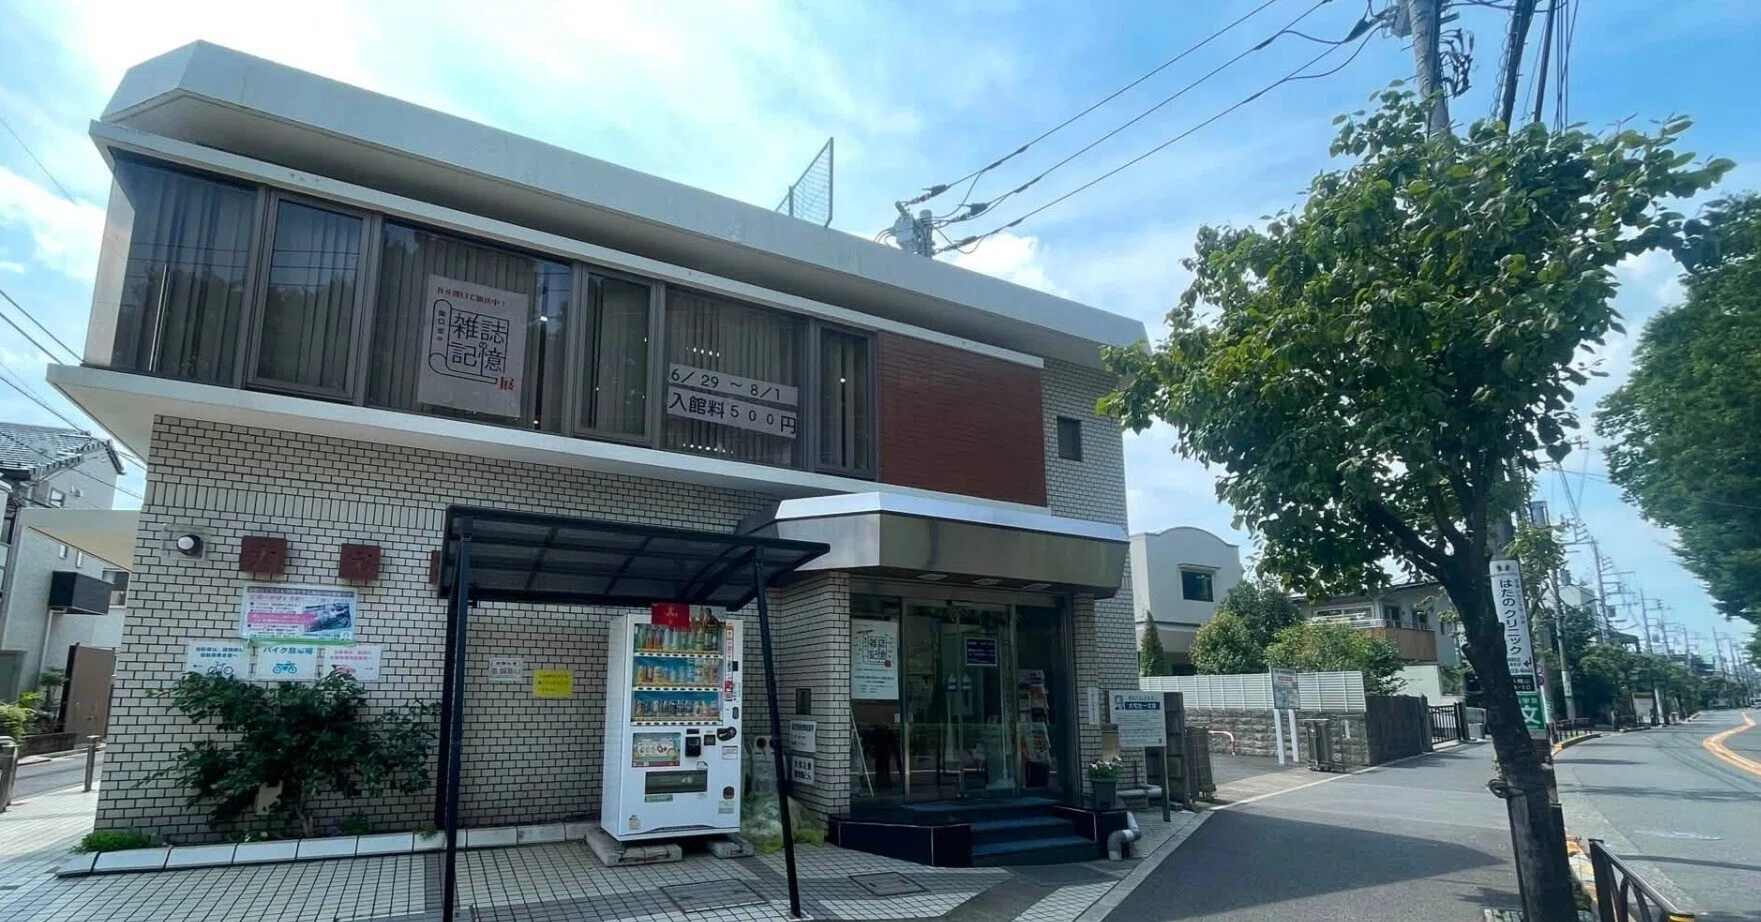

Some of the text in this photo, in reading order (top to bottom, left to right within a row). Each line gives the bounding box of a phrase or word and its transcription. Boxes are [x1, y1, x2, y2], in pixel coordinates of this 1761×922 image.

[750, 384, 780, 401] 8/1
[1500, 578, 1523, 655] はたのクリニック
